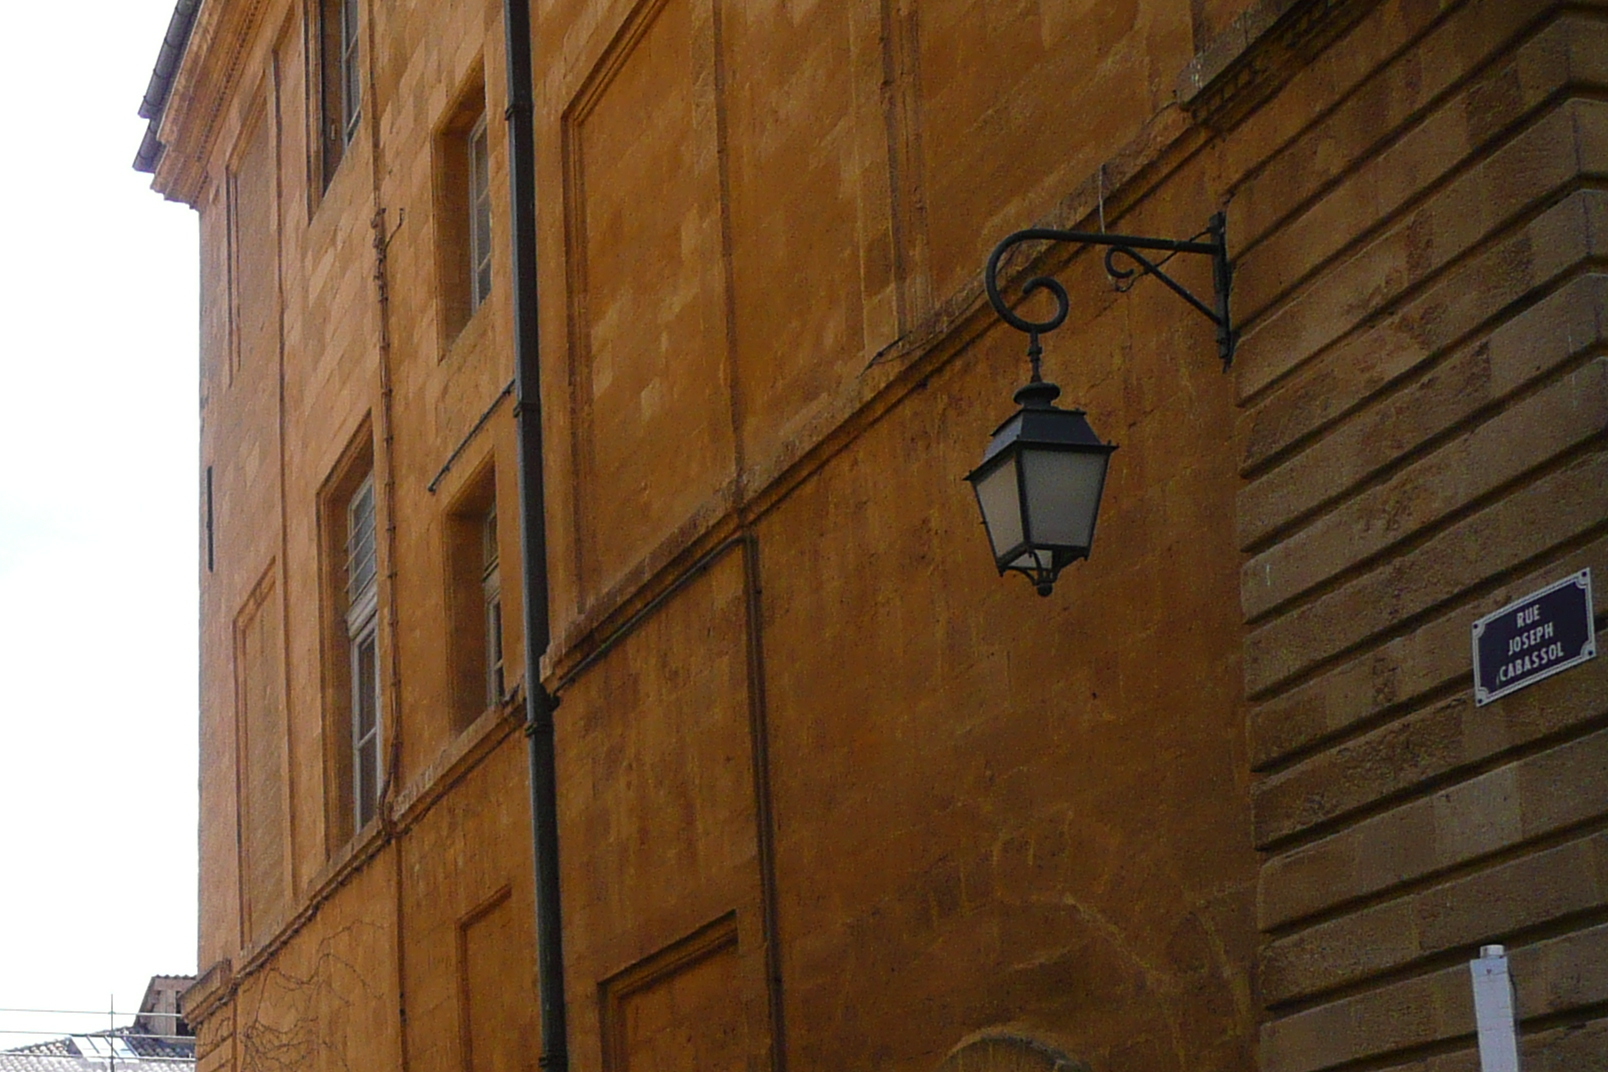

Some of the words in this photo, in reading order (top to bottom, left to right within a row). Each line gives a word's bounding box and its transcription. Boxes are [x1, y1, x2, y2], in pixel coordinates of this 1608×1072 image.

[1516, 604, 1541, 629] RUE
[1508, 622, 1554, 657] JOSEPH
[1499, 641, 1565, 681] CABASSOL
